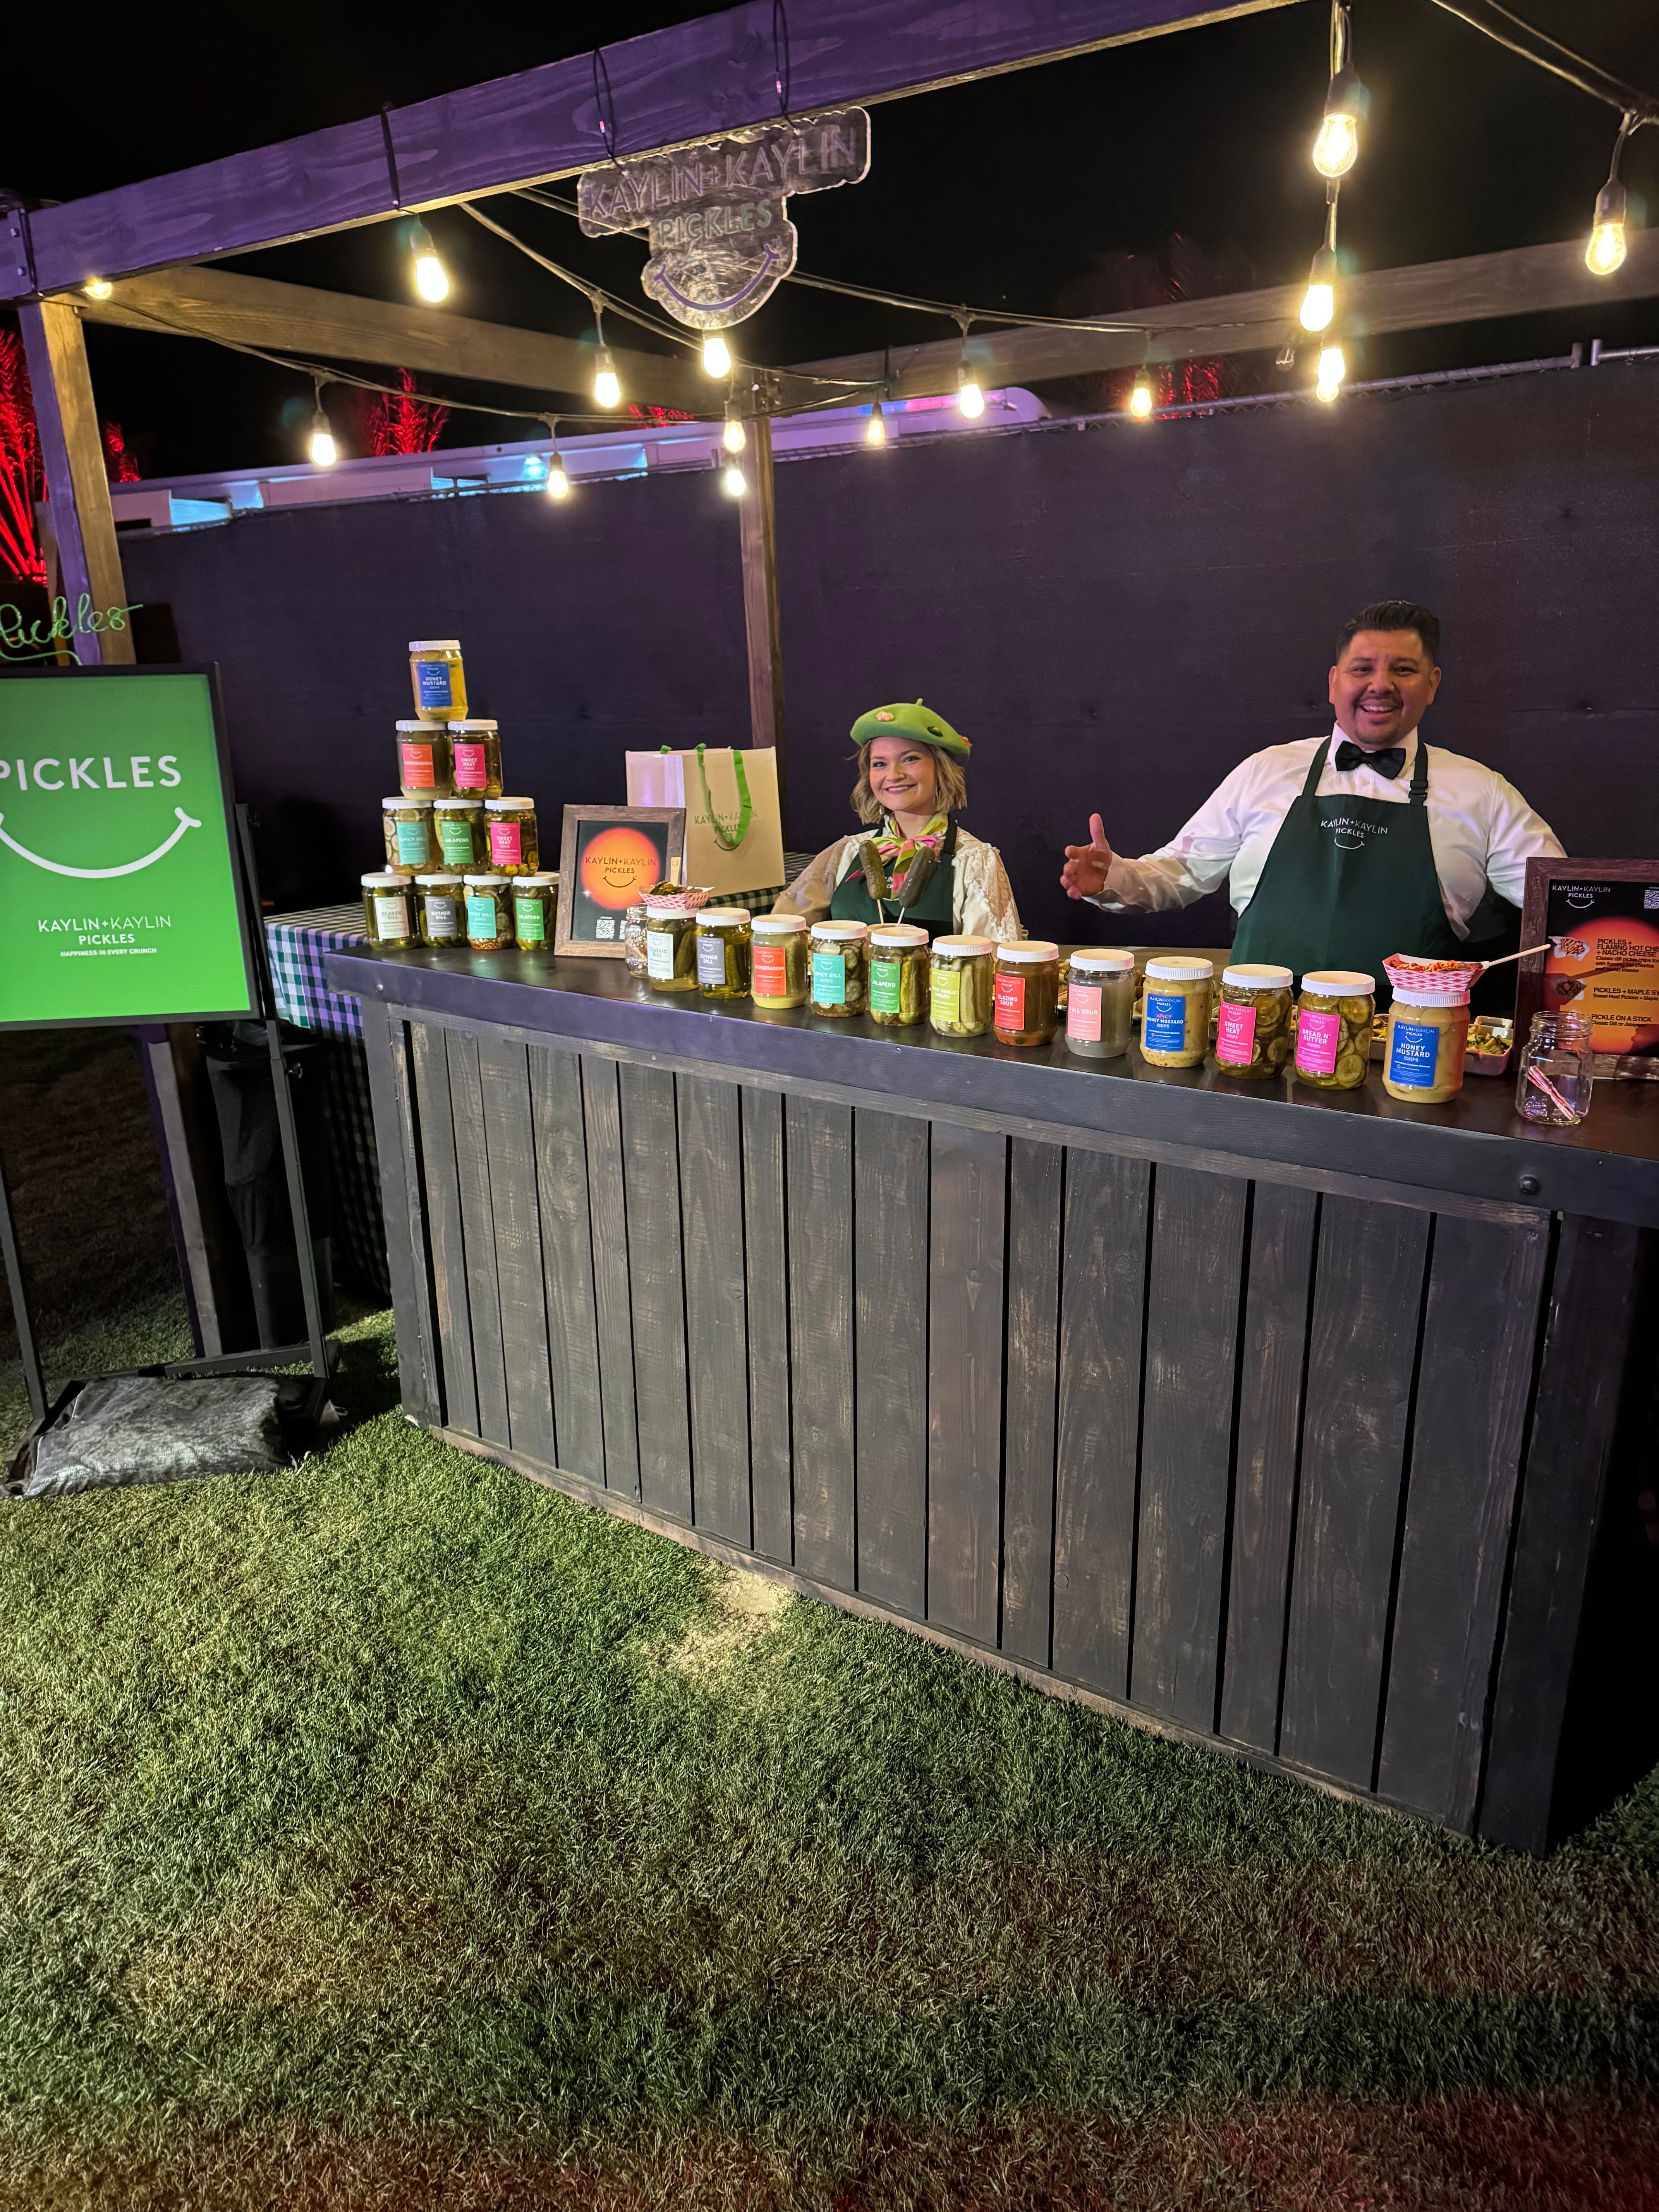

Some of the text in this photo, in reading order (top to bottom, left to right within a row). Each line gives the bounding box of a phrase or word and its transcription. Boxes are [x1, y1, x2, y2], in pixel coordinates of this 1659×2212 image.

[661, 200, 771, 245] PICKLES
[586, 857, 656, 866] KAYLIN+KAYLIN
[38, 915, 171, 932] KAYLIN+KAYLIN
[79, 934, 135, 945] PICKLES
[998, 994, 1018, 1002] BLAZING
[1224, 1020, 1244, 1030] SWEET
[1226, 1027, 1240, 1035] HEAT
[1302, 1028, 1321, 1037] BREAD
[1303, 1034, 1328, 1044] BUTTER
[1401, 1042, 1425, 1051] HONEY
[1396, 1047, 1430, 1058] MUSTARD
